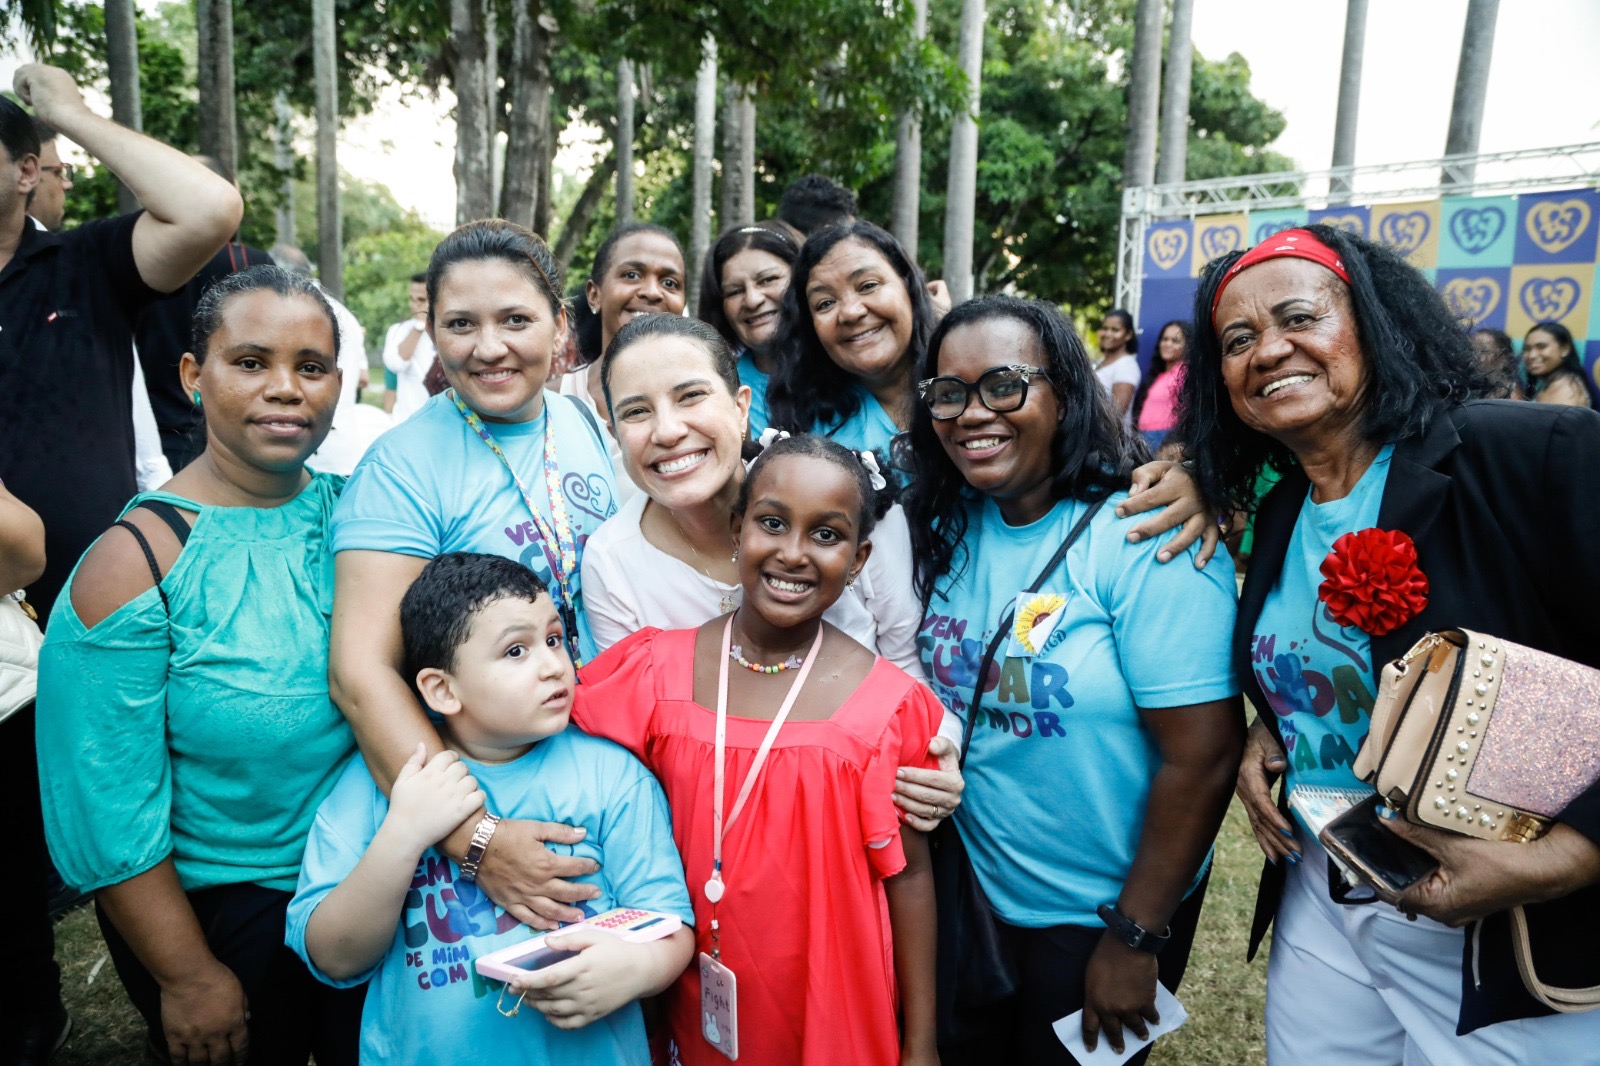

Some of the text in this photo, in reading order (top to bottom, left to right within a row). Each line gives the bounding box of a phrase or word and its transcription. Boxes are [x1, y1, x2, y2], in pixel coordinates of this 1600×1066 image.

[1251, 633, 1277, 663] EM
[1254, 665, 1376, 725] UDA
[411, 857, 453, 889] EM
[405, 951, 424, 968] DE
[417, 963, 469, 991] COM
[704, 987, 731, 1013] Fight
